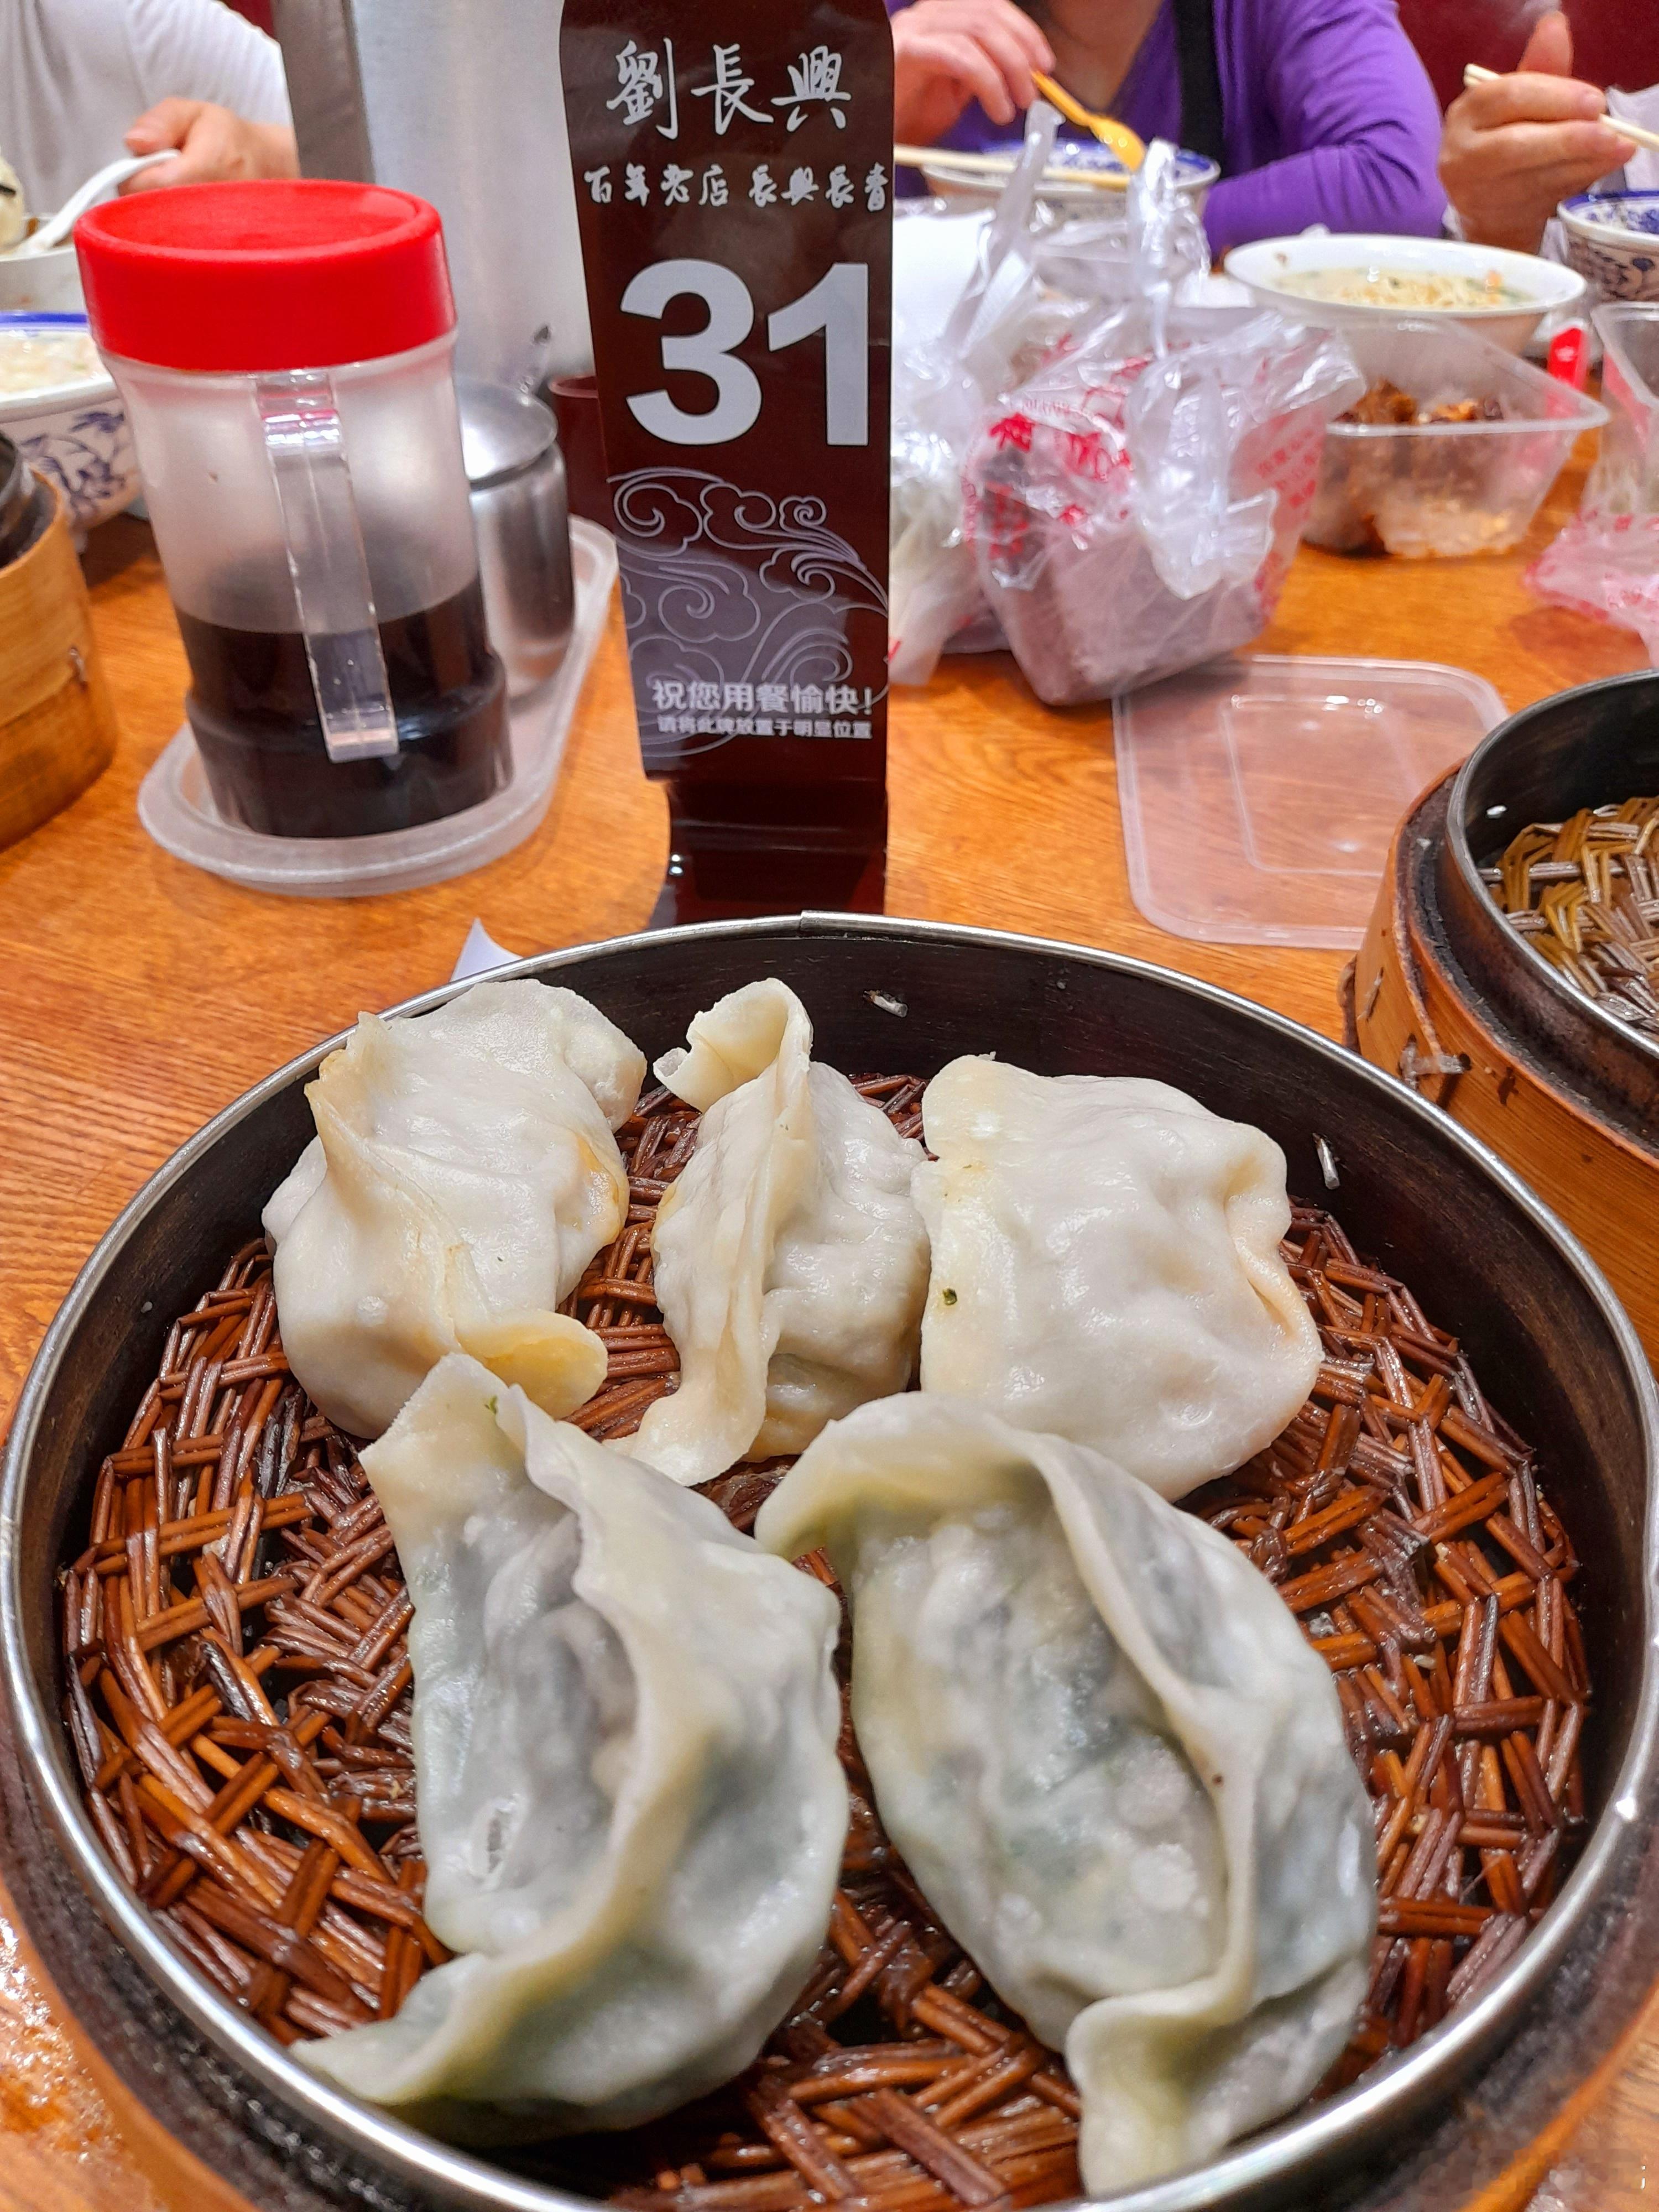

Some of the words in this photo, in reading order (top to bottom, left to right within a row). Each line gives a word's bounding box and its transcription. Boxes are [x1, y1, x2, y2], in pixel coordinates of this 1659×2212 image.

[607, 37, 852, 139] 劉長興
[584, 163, 729, 207] 百年老店
[620, 258, 868, 446] 31
